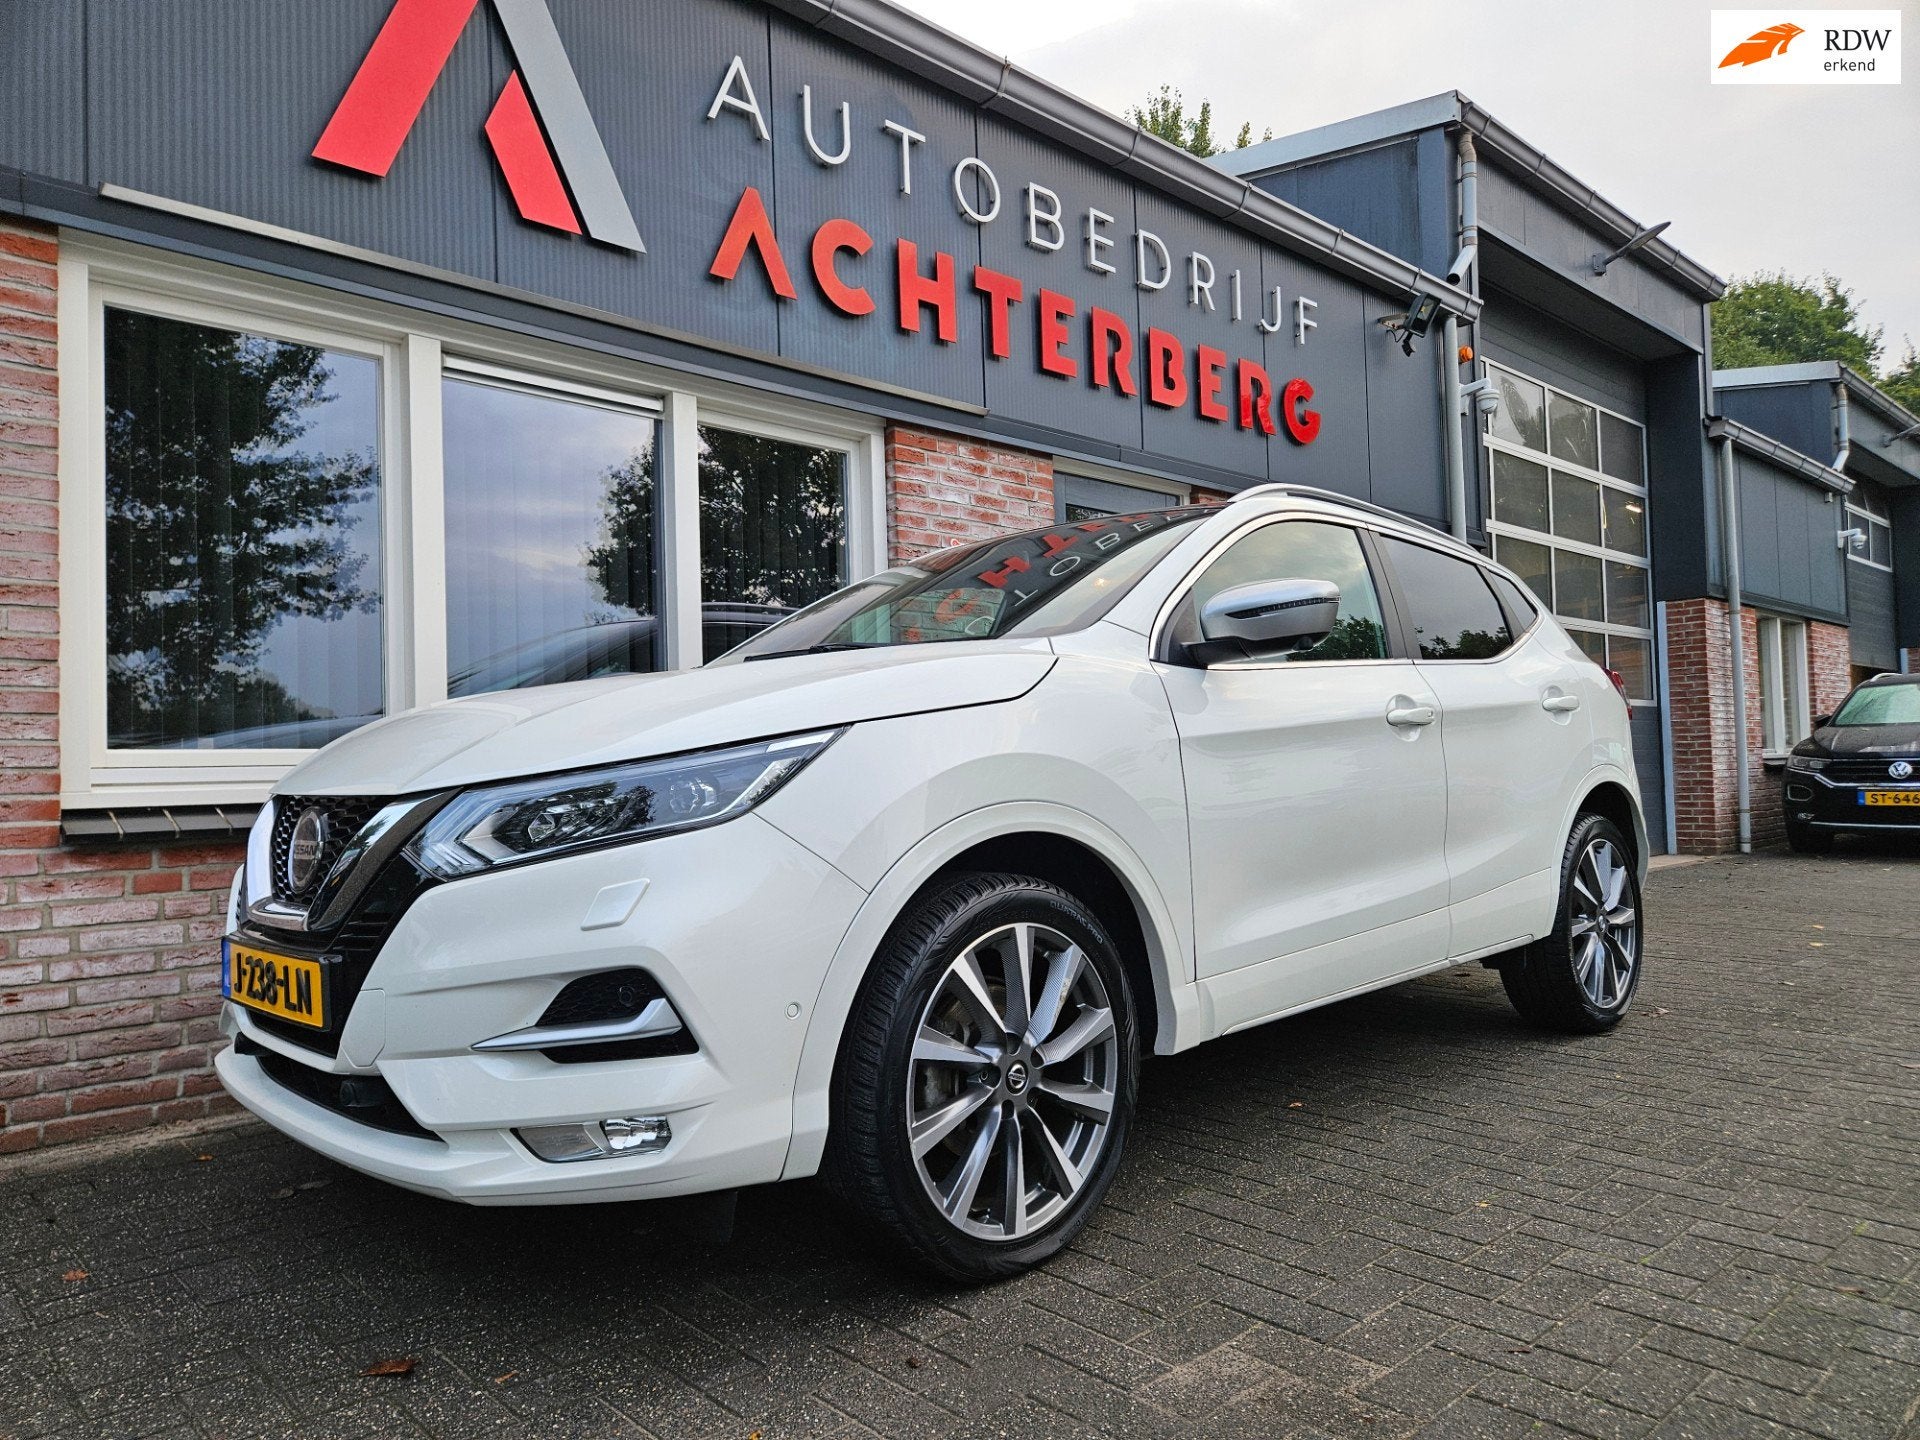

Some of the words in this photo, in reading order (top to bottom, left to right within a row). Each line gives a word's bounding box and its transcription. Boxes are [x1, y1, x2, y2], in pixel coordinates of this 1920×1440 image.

[706, 55, 1319, 345] AUTOBEDRIJF
[709, 186, 1322, 446] ACHTERBERG
[233, 952, 313, 1016] J-238-LN
